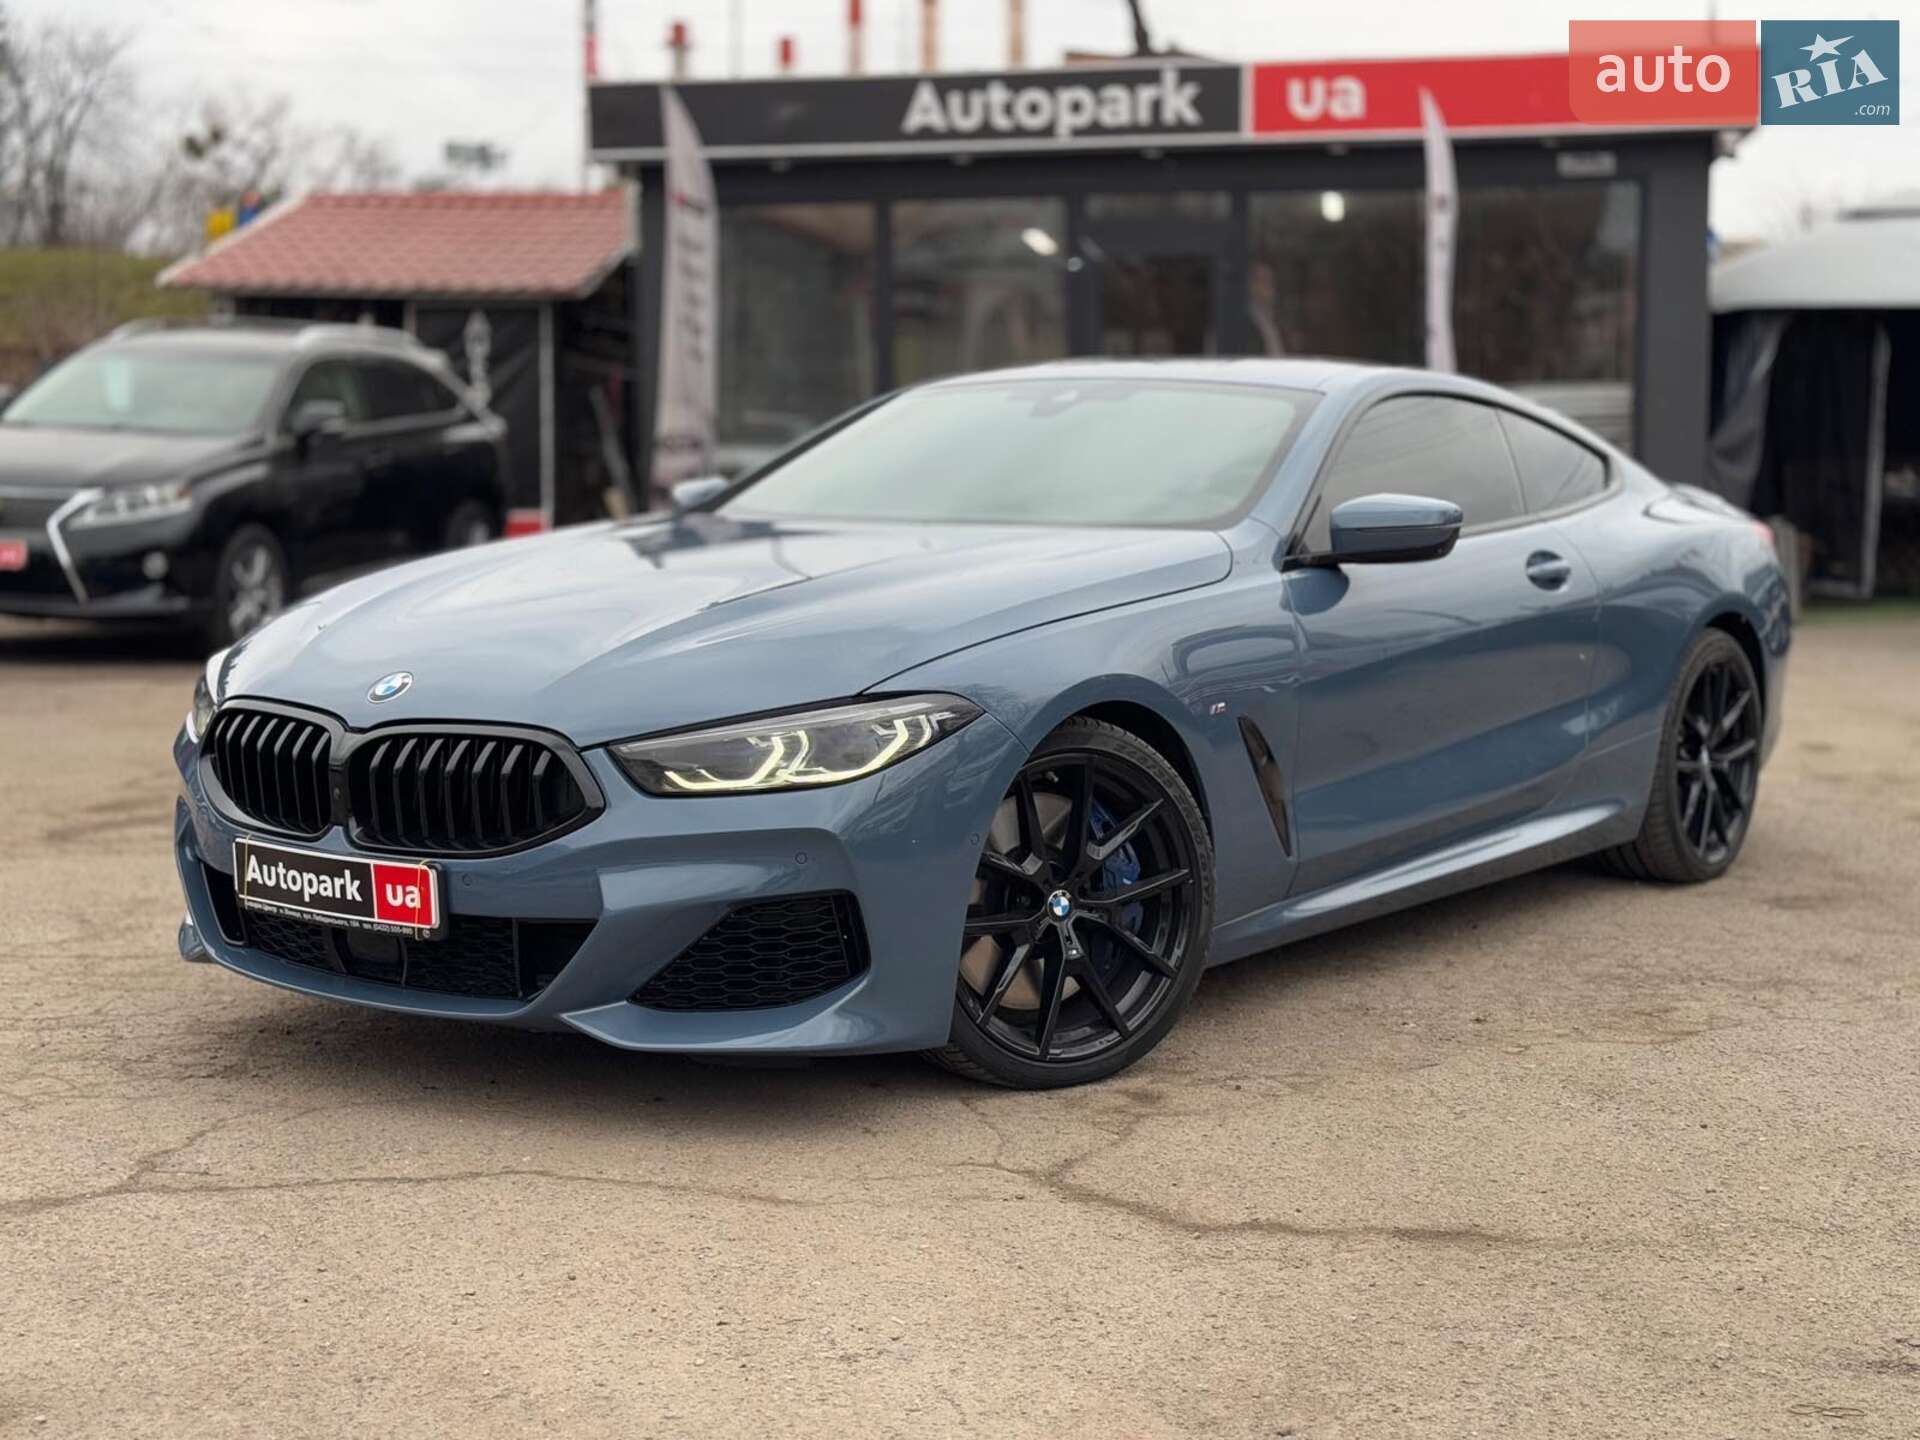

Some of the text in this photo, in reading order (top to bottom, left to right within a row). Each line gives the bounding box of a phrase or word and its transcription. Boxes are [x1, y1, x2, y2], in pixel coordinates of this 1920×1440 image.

[901, 64, 1368, 142] Autopark ua
[246, 854, 421, 909] Autopark ua
